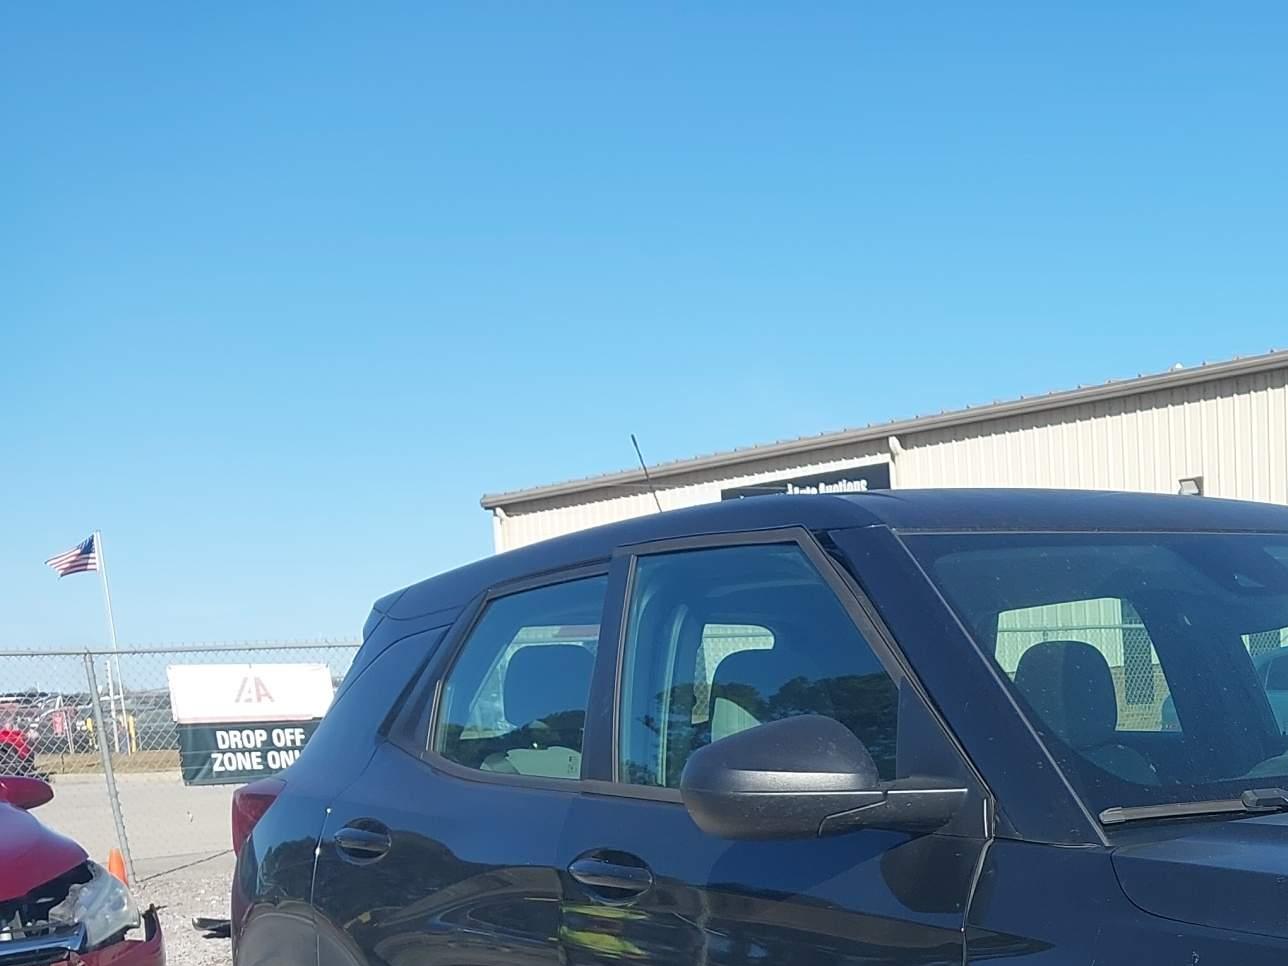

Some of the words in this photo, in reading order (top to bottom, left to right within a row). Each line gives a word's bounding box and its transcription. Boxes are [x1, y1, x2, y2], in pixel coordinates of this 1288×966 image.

[215, 729, 267, 750] DROP
[272, 728, 306, 748] OFF
[211, 750, 265, 772] ZONE
